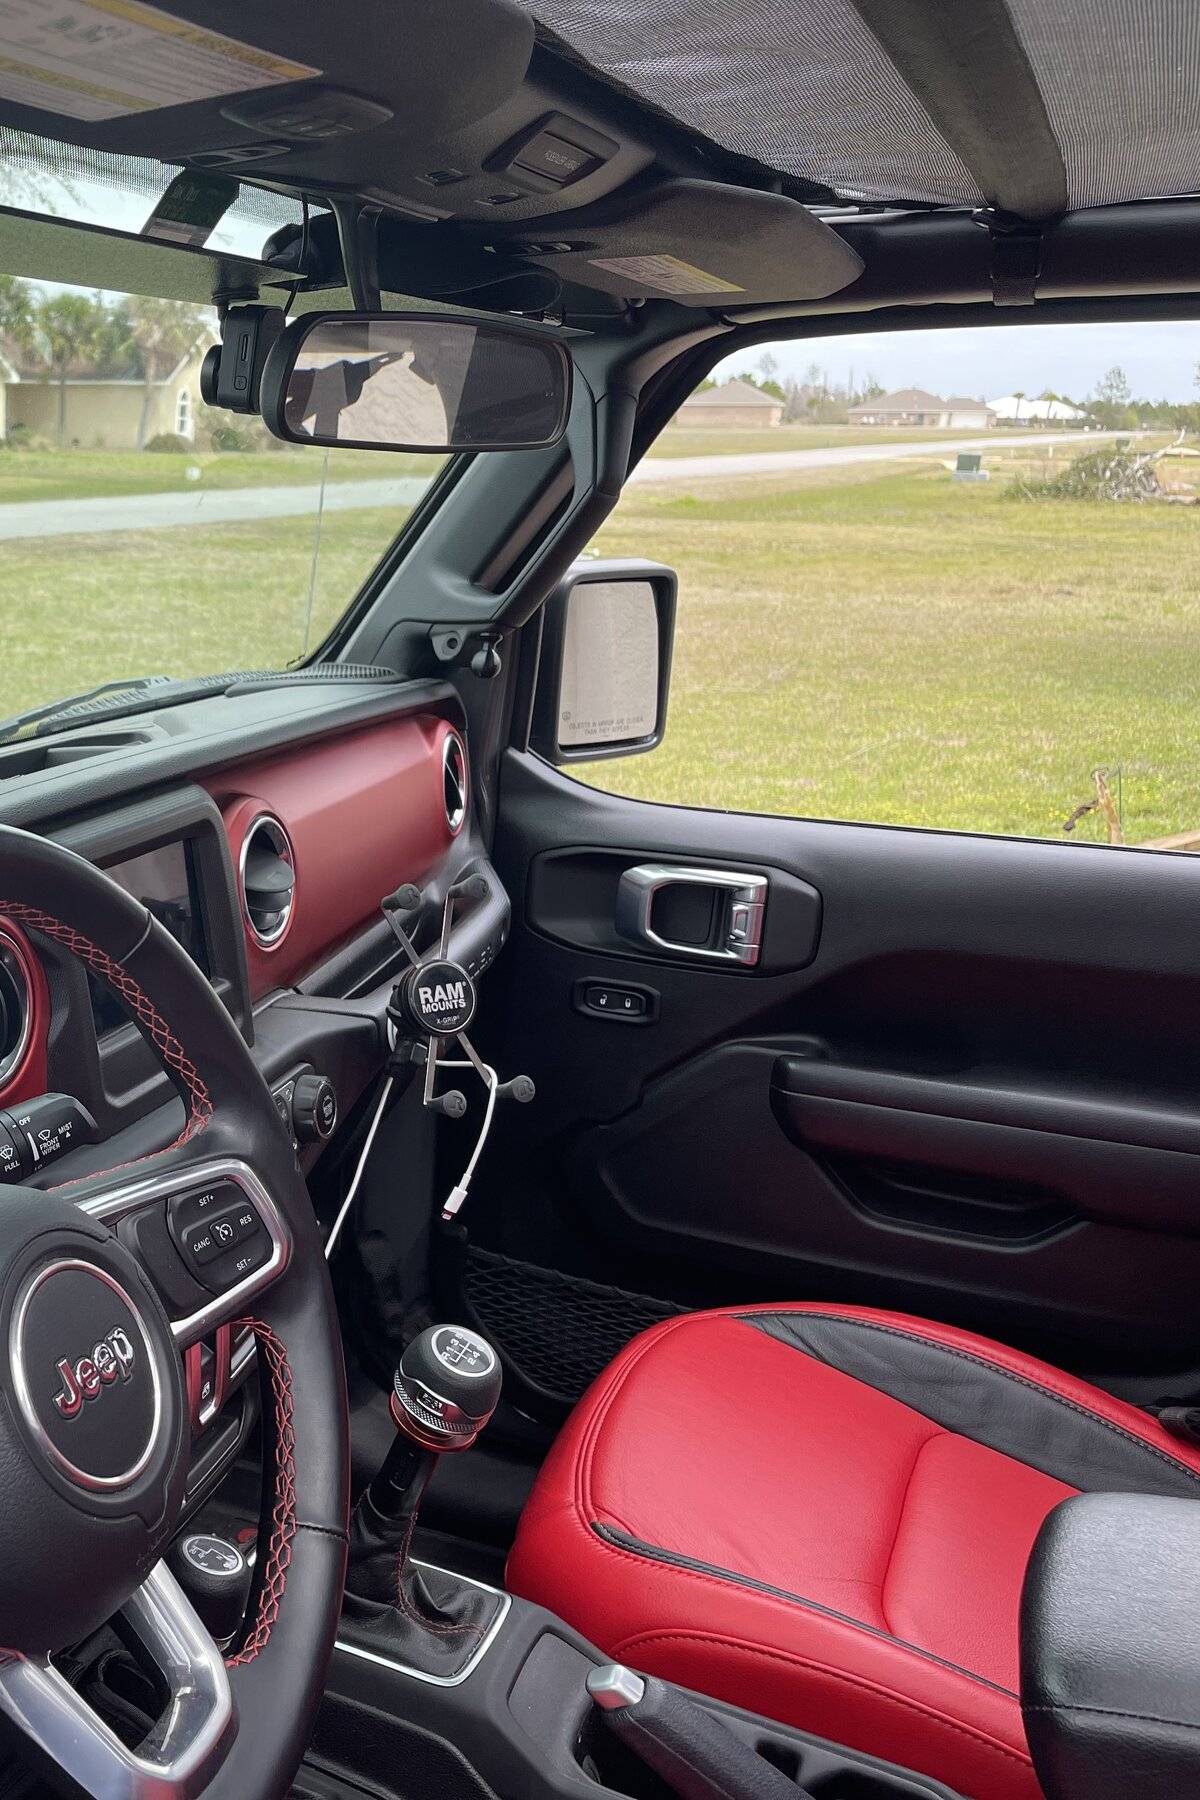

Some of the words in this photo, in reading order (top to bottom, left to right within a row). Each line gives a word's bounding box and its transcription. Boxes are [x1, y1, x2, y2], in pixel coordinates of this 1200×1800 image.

[421, 998, 466, 1014] MOUNTS
[18, 1115, 31, 1126] OFF
[57, 1121, 73, 1135] MIST
[39, 1136, 59, 1151] FRONT
[41, 1142, 61, 1156] WIPER
[4, 1160, 21, 1172] PULL
[239, 1214, 252, 1226] RES
[193, 1237, 211, 1252] CANC
[54, 1326, 134, 1418] Jeep
